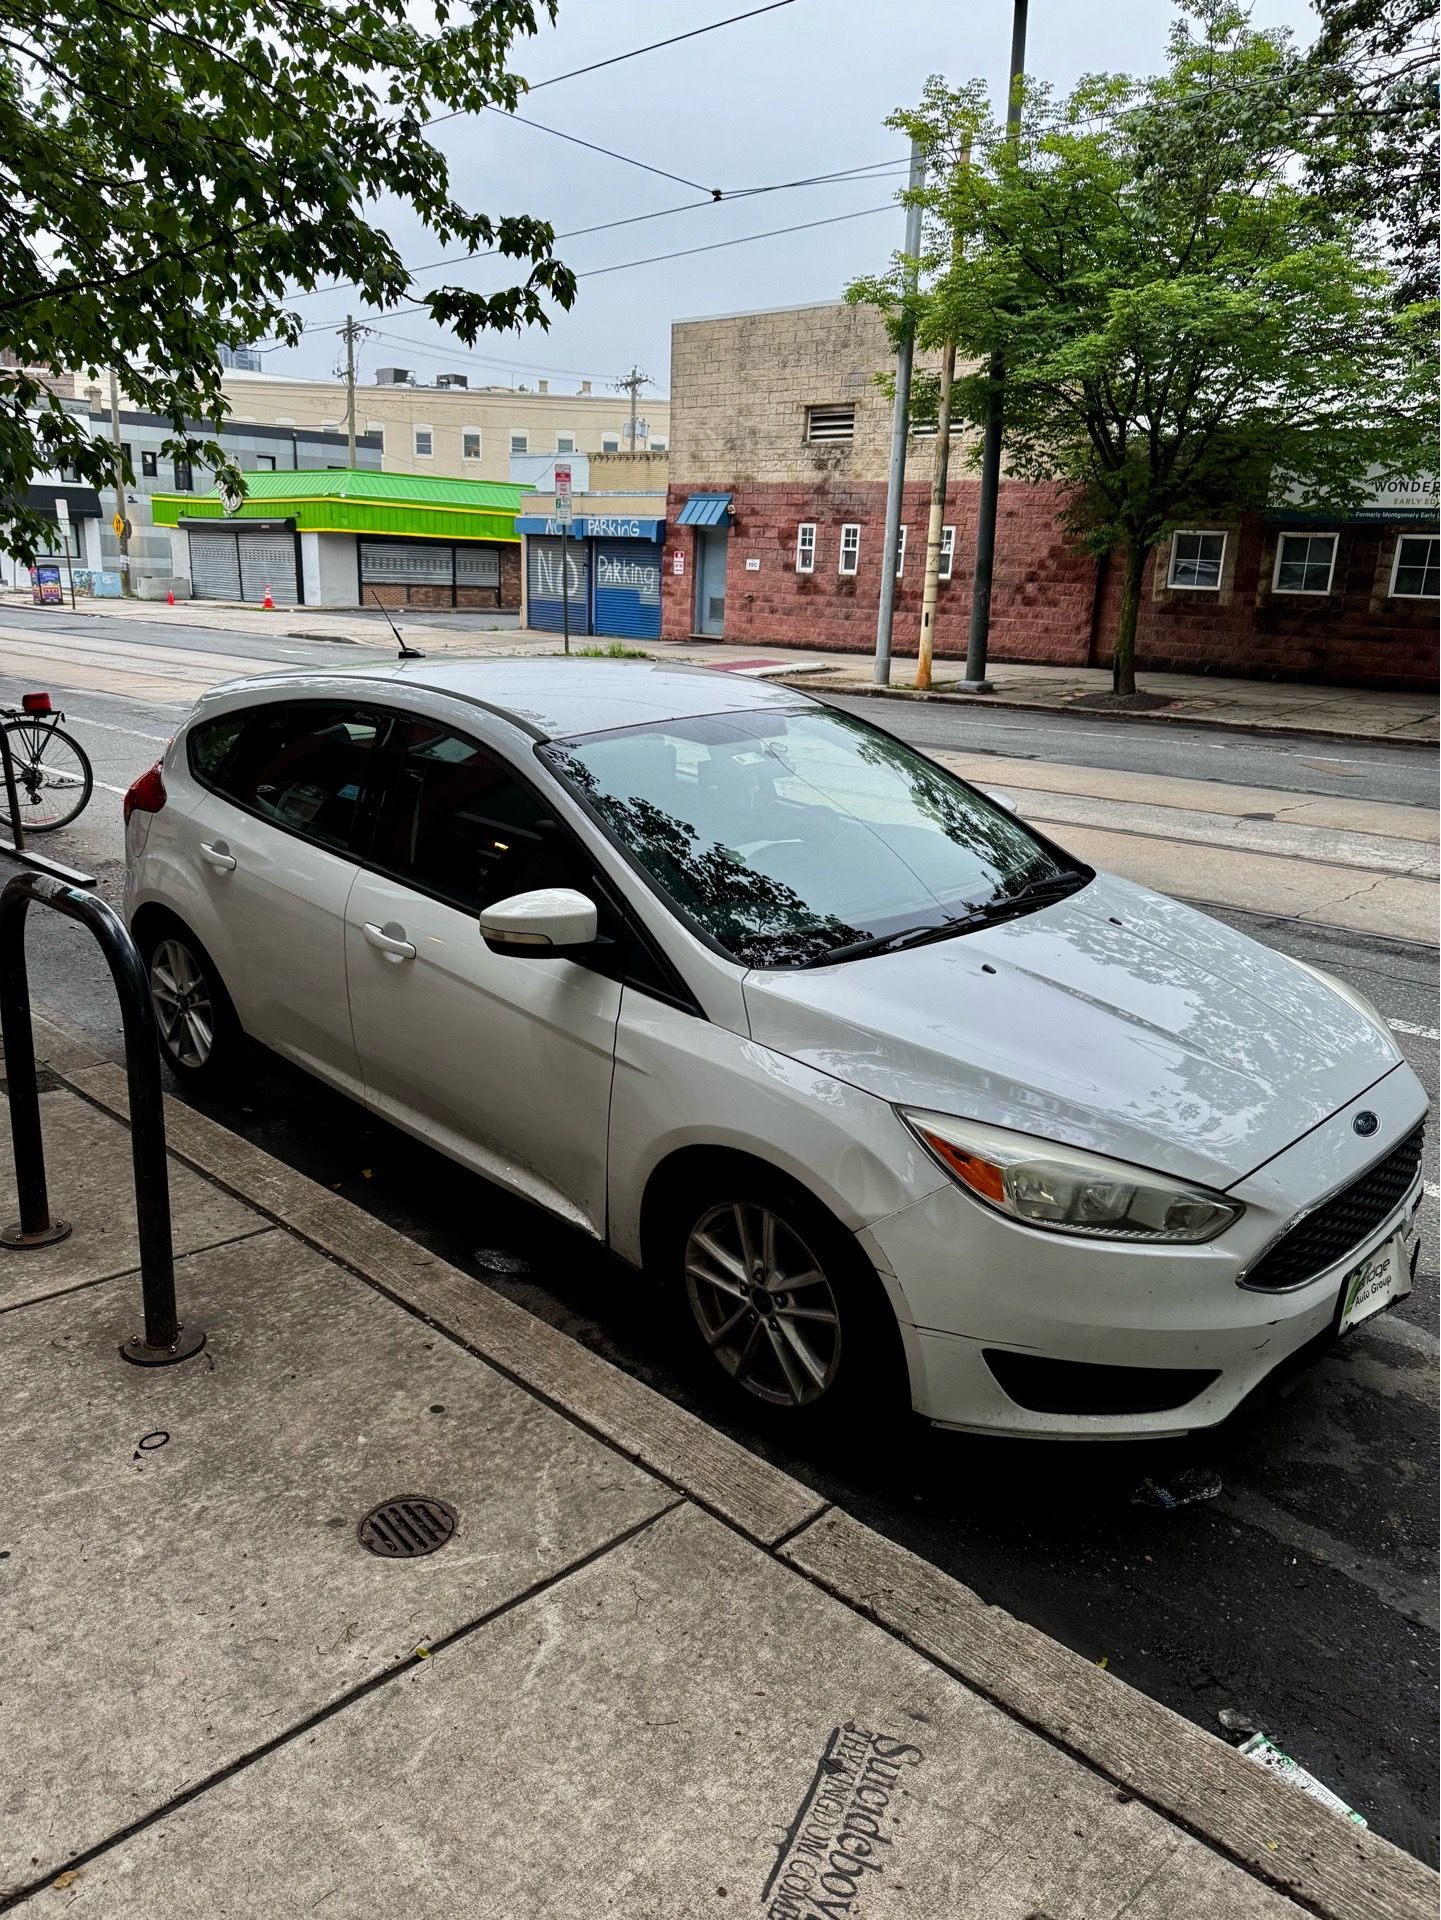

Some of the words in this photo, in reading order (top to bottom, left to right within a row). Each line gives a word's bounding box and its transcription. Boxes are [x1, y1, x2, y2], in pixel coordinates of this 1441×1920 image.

[1355, 511, 1381, 519] Formerly
[1381, 511, 1420, 520] Montgomery
[537, 547, 578, 596] NO
[1371, 1274, 1392, 1294] Group
